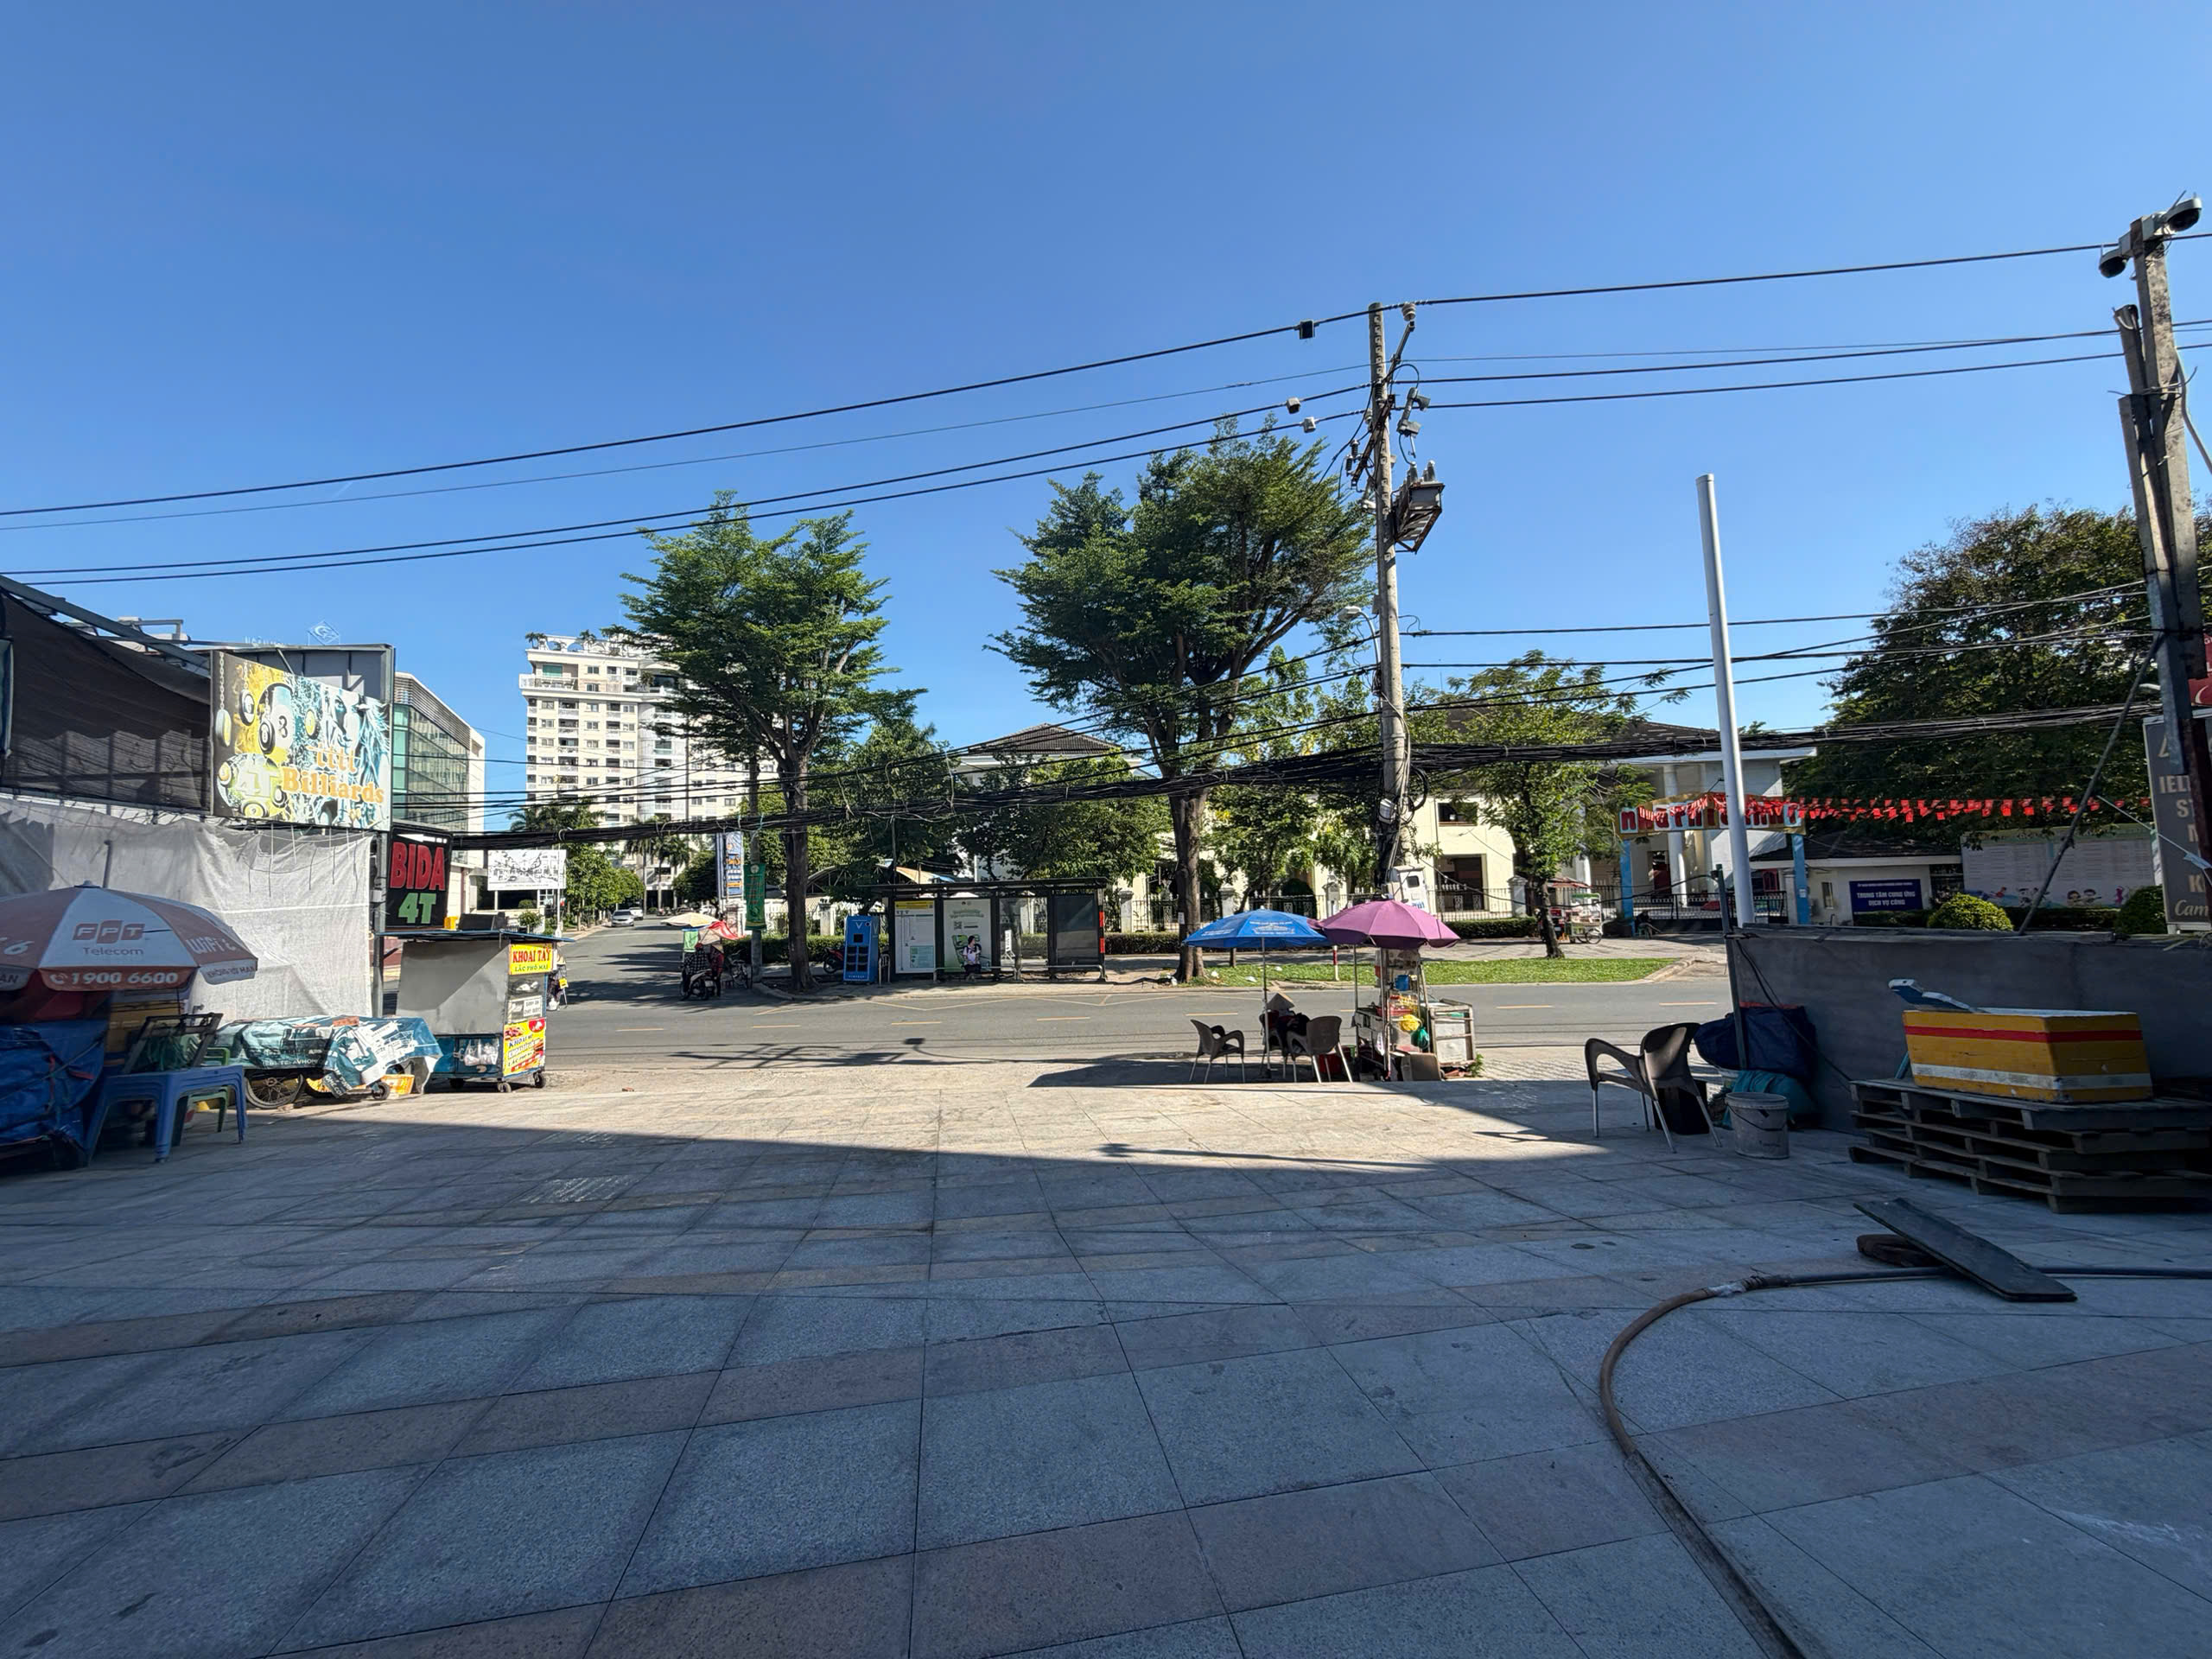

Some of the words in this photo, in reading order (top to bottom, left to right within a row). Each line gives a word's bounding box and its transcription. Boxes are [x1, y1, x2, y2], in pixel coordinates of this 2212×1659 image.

[281, 766, 385, 804] Billiards
[390, 842, 446, 891] BIDA
[398, 892, 436, 925] 4T
[75, 924, 144, 940] FPT
[83, 947, 144, 957] Telecom
[186, 936, 226, 955] WiFi
[512, 950, 537, 963] KHOAI
[71, 973, 124, 985] 1900
[127, 972, 179, 984] 6600
